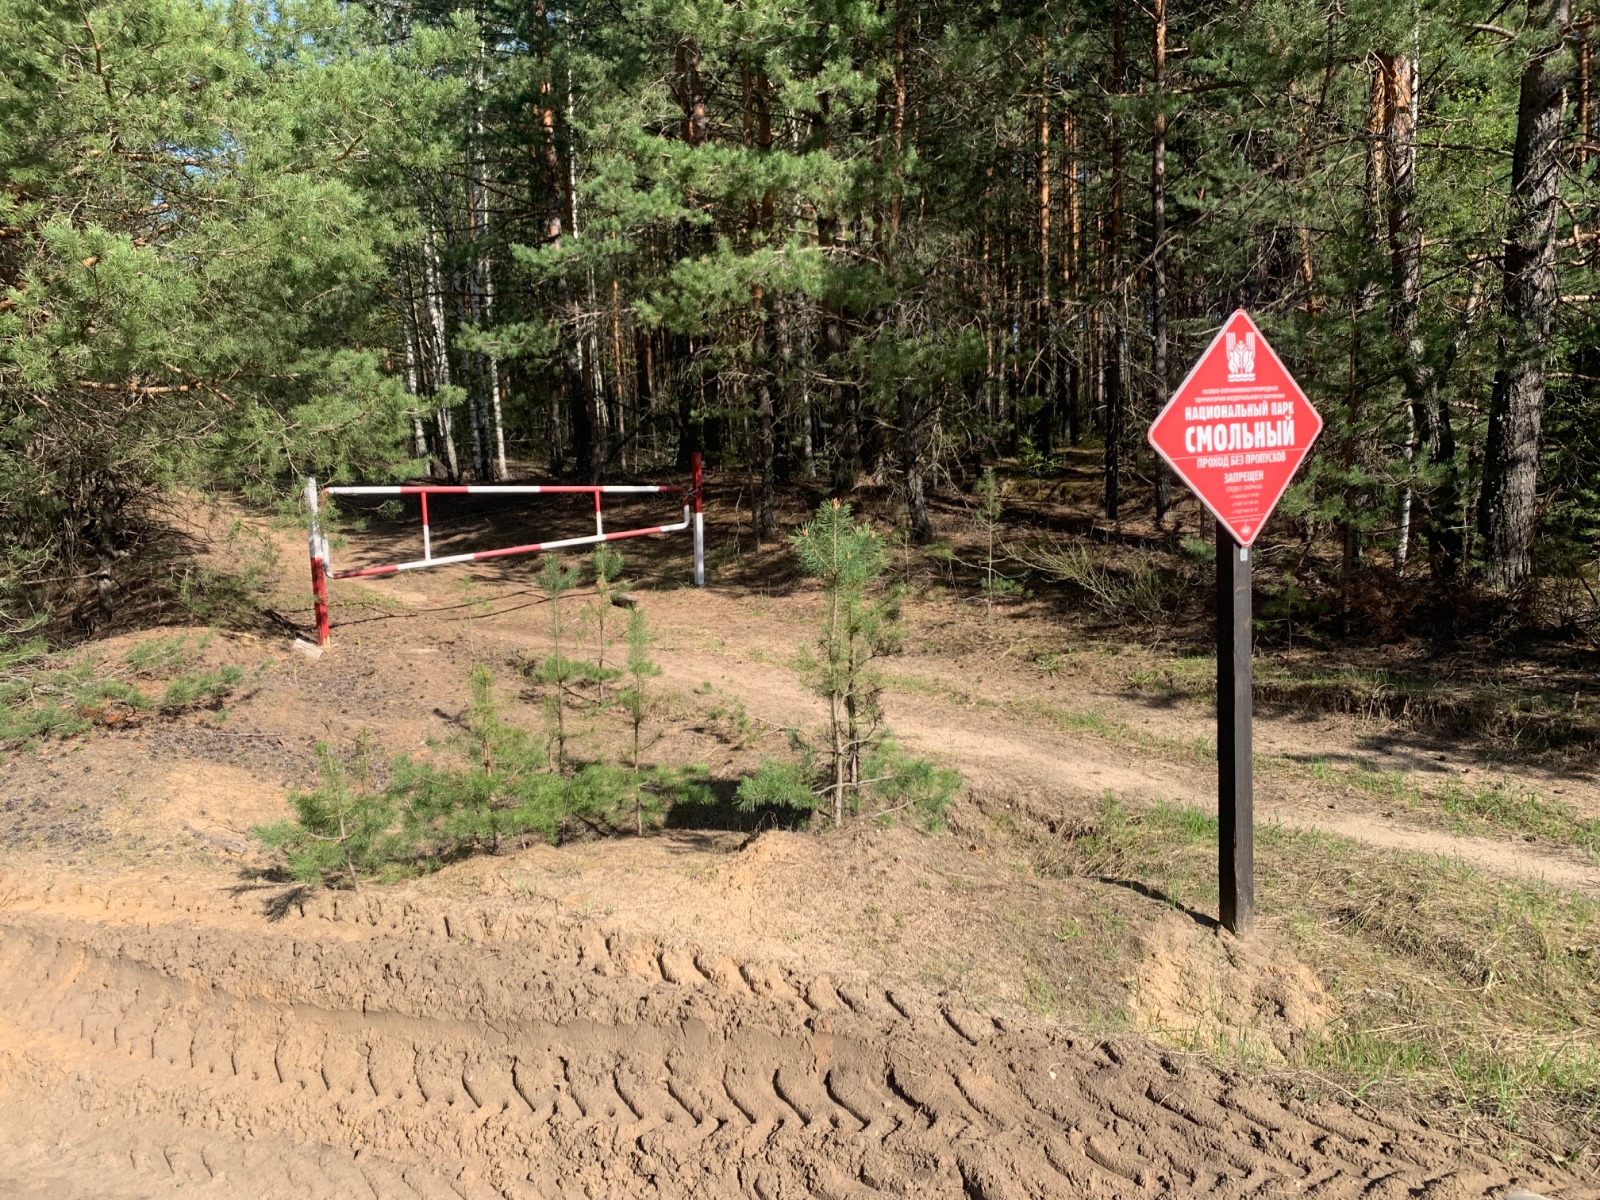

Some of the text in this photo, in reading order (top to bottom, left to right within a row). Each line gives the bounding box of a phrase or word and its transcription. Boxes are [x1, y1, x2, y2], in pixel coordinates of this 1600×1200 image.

[1185, 401, 1294, 421] НАЦИОНАЛЬНЫЙ ПАРК
[1185, 416, 1295, 453] СМОЛЬНЫЙ
[1197, 452, 1286, 469] ПРОХОД БЕЗ ПРОПУСКОВ
[1223, 470, 1264, 483] ЗАПРЕЩЕН
